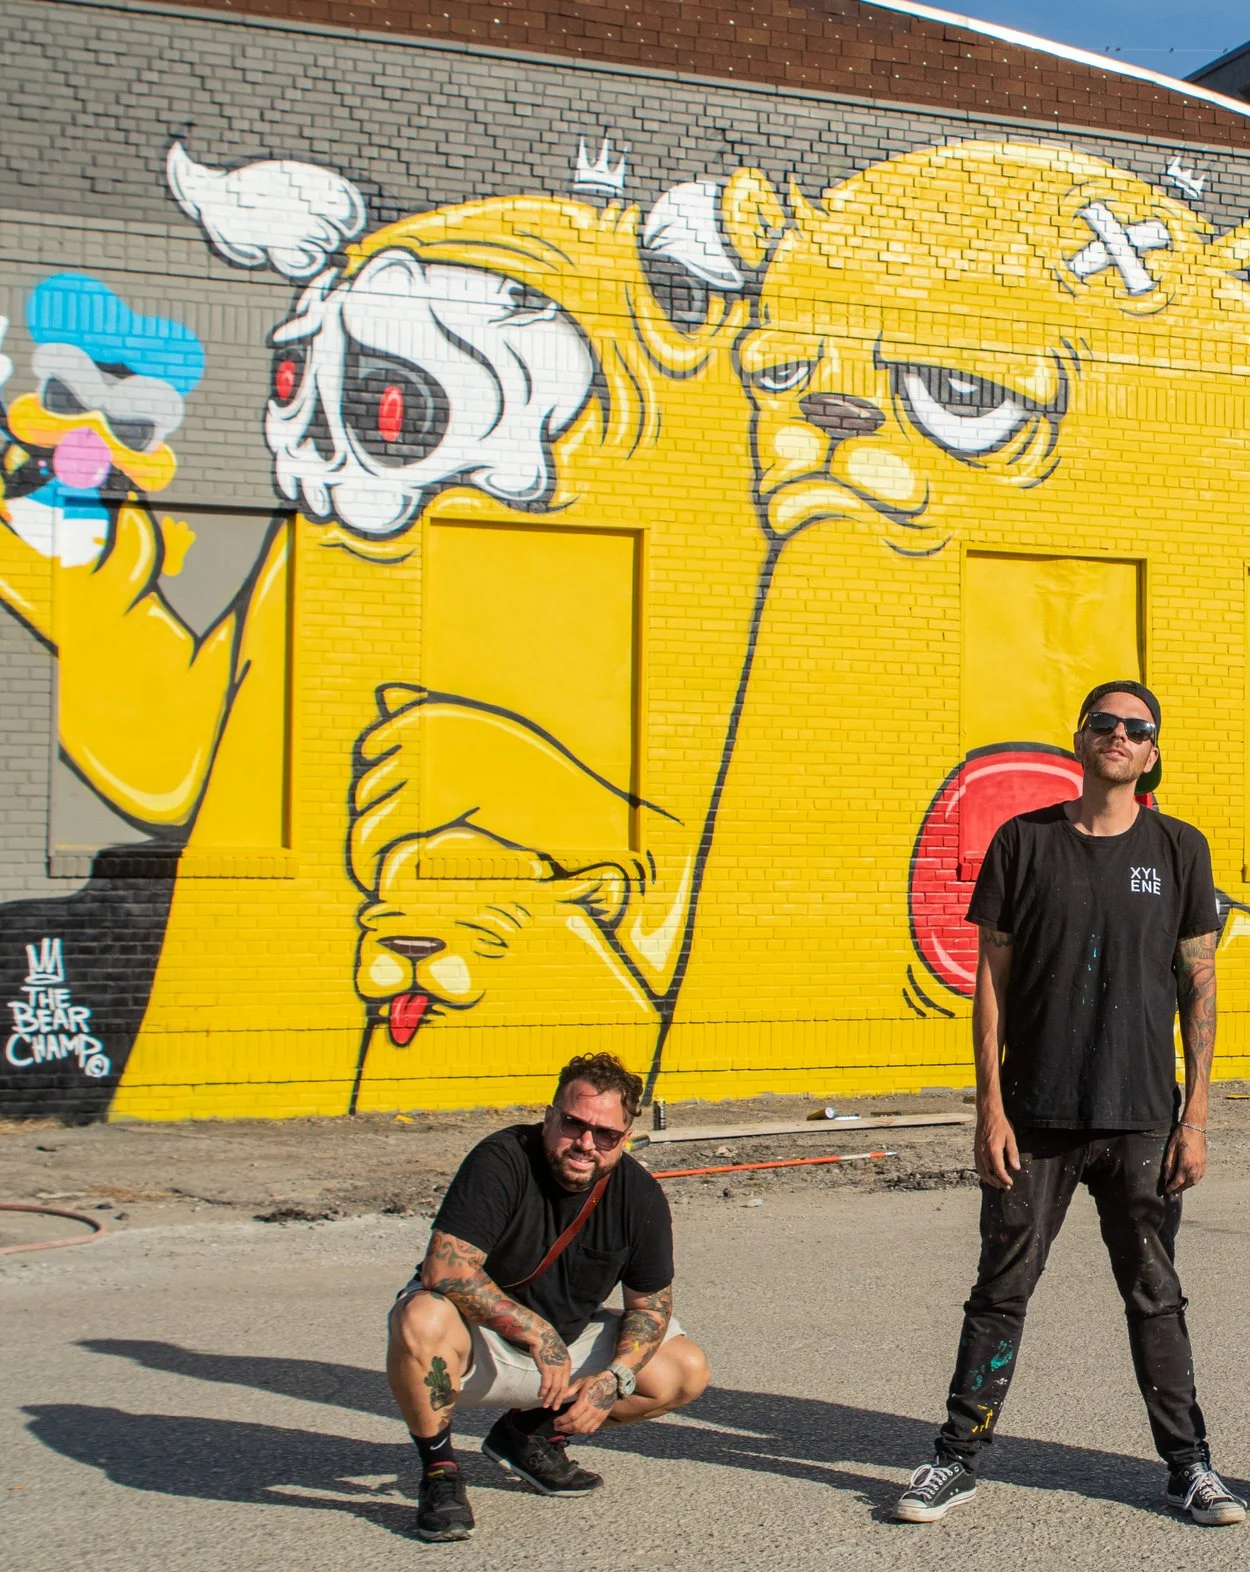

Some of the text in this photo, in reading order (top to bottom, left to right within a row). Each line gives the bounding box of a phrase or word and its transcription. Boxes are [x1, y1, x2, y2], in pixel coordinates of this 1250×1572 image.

[1130, 866, 1161, 881] XYL
[1130, 879, 1161, 895] ENE
[20, 985, 71, 1010] THE
[7, 1001, 91, 1034] BEAR
[6, 1033, 104, 1068] CHAMP
